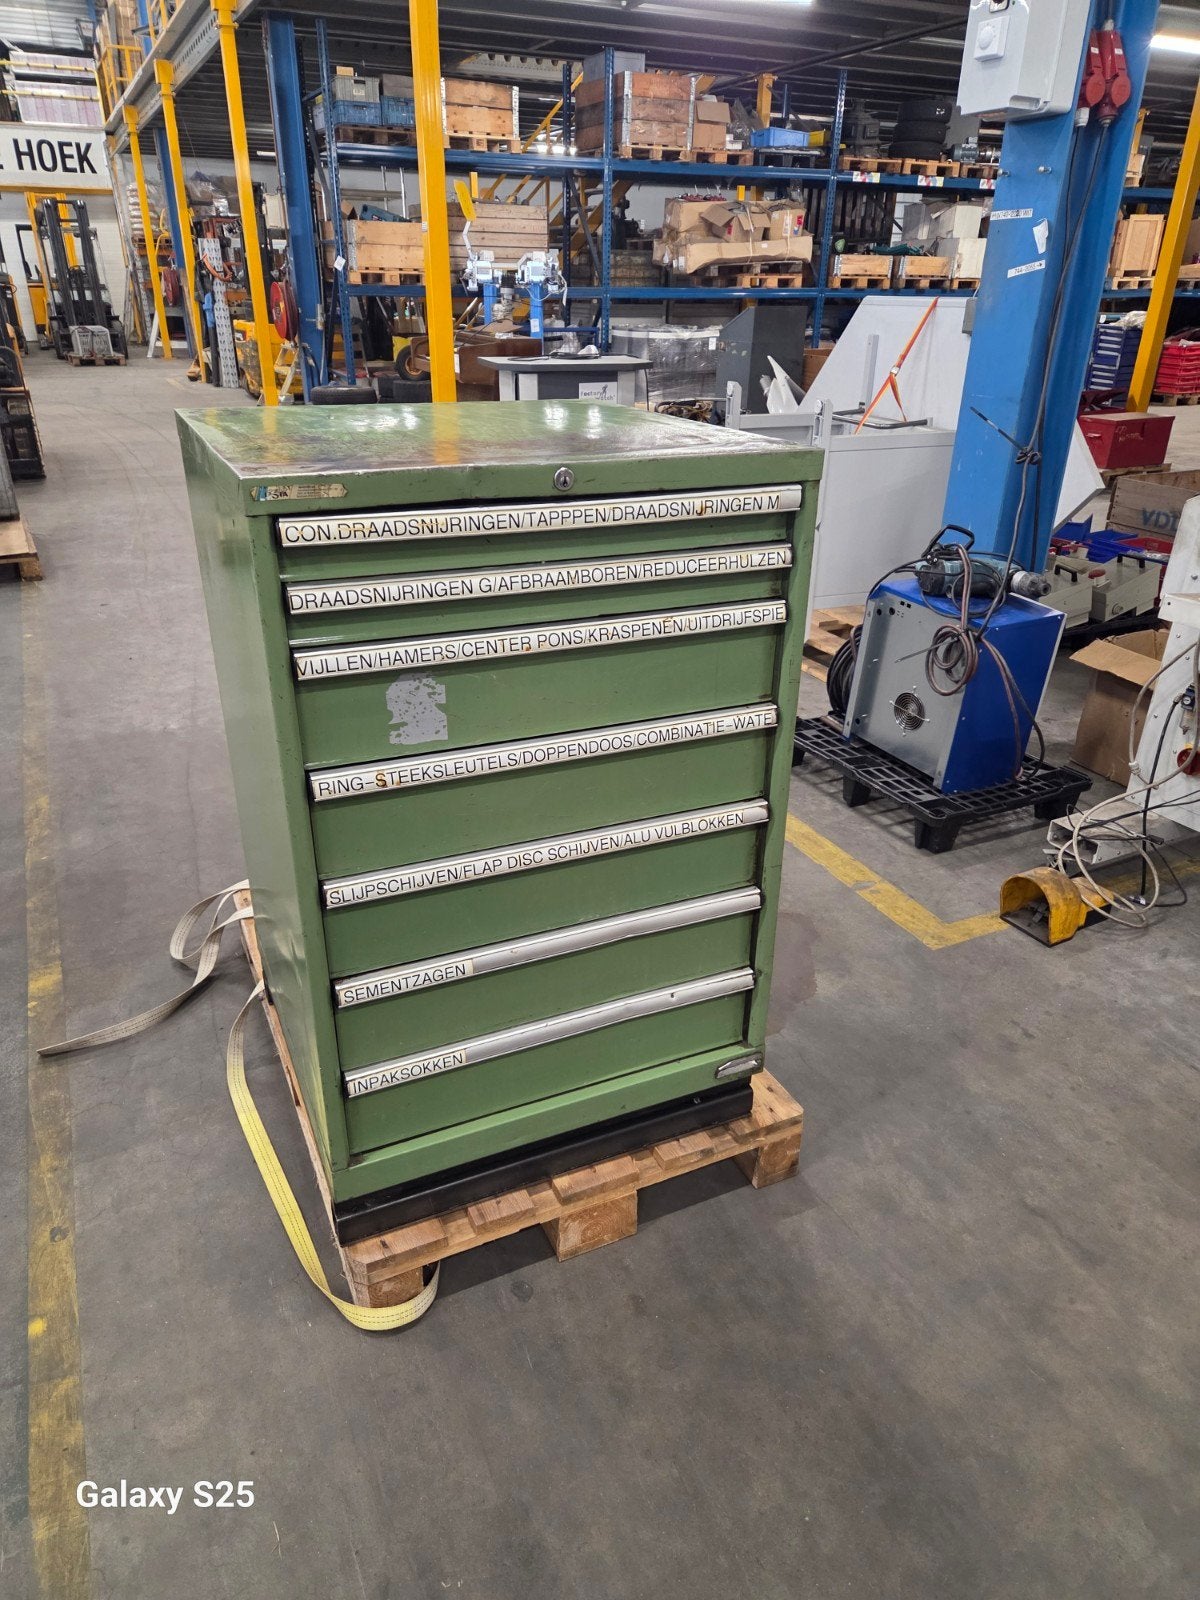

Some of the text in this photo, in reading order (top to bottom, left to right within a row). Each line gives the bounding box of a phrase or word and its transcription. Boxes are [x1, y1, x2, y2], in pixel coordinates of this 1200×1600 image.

[12, 137, 97, 174] HOEK
[767, 495, 780, 510] M
[290, 579, 473, 611] DRAADSNIJRINGEN
[296, 636, 532, 676] VIJLLEN/HAMERS/CENTER
[329, 812, 744, 905] SLIJPSCHIJVEN/FLAP DISC SCHIJVEN/ALU VULBLOKKEN
[343, 963, 466, 1003] SEMENTZAGEN
[352, 1052, 463, 1094] INPAKSOKKEN
